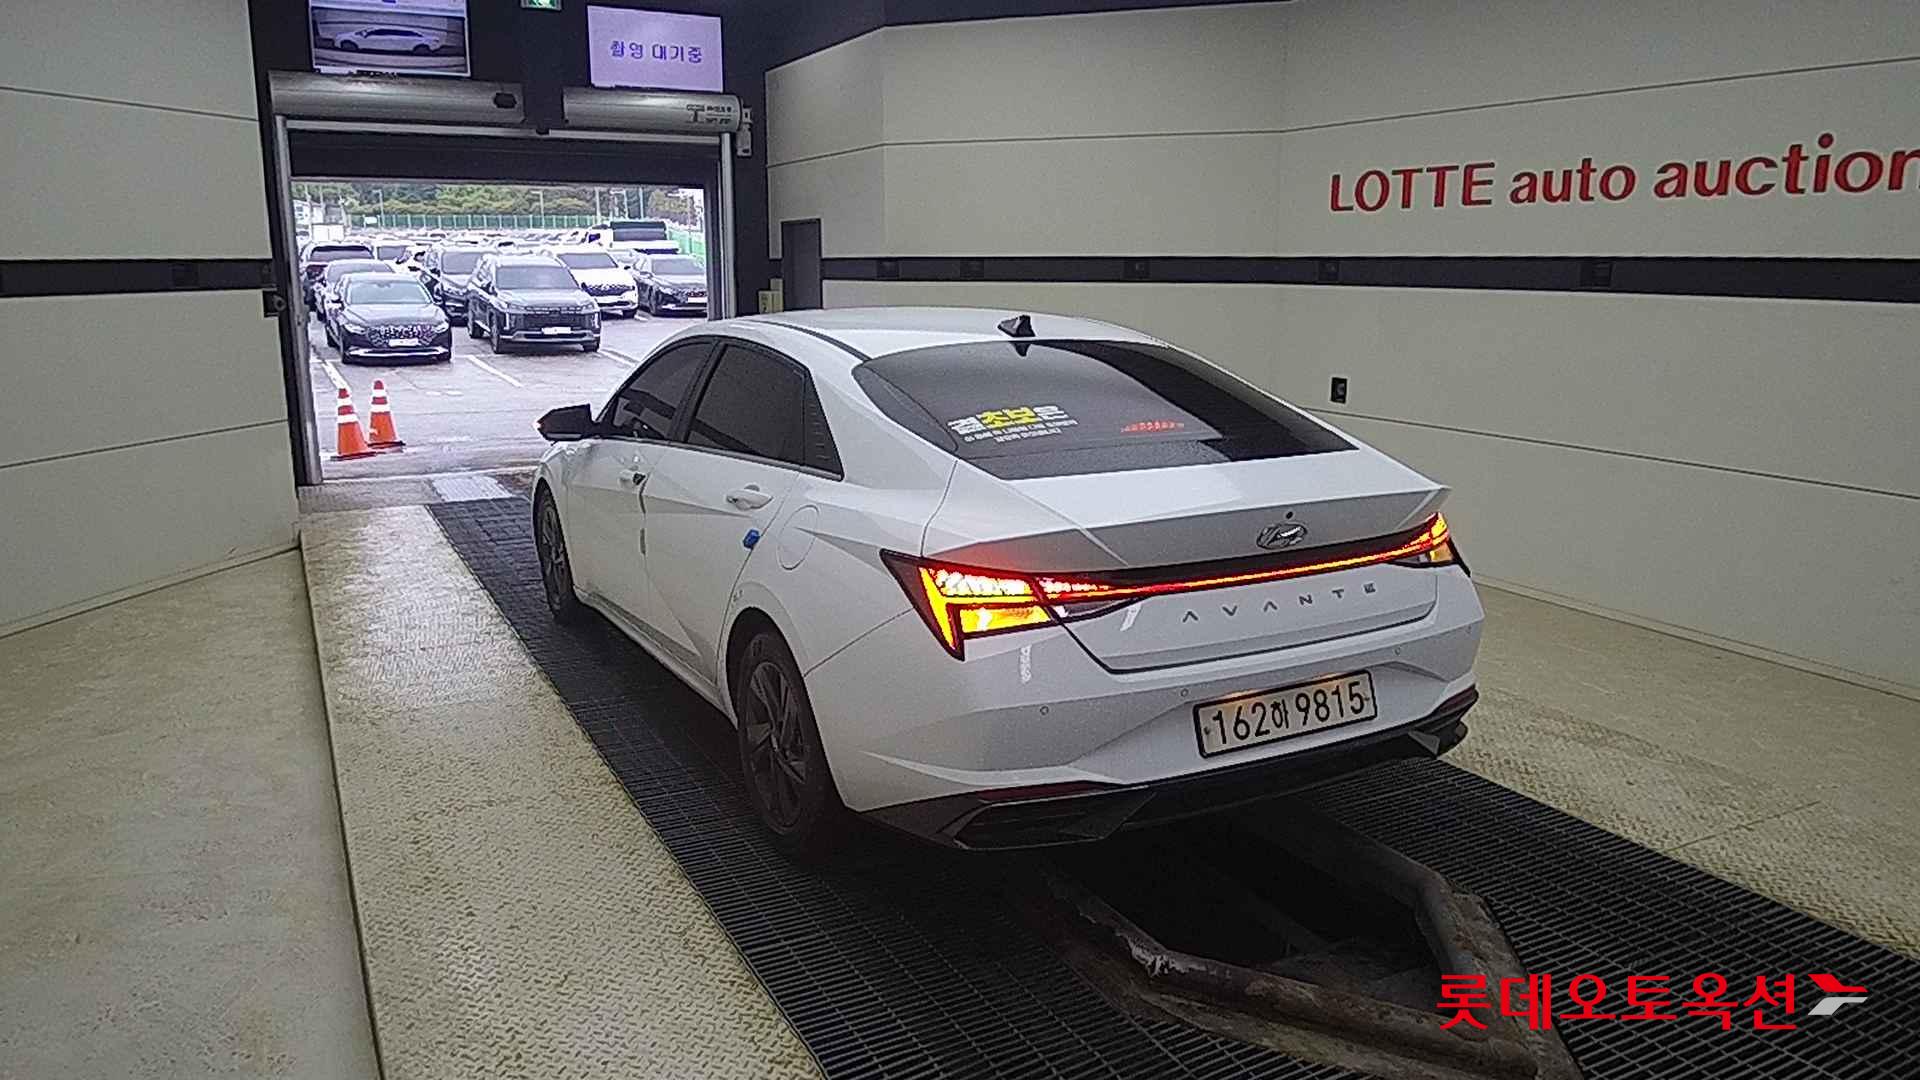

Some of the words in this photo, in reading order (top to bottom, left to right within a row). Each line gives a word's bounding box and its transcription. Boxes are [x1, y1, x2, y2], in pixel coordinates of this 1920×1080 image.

[610, 40, 644, 60] 촬영
[651, 43, 702, 64] 대기중
[1330, 161, 1496, 212] LOTTE
[1510, 157, 1637, 205] auto
[1182, 583, 1376, 623] AVANTE
